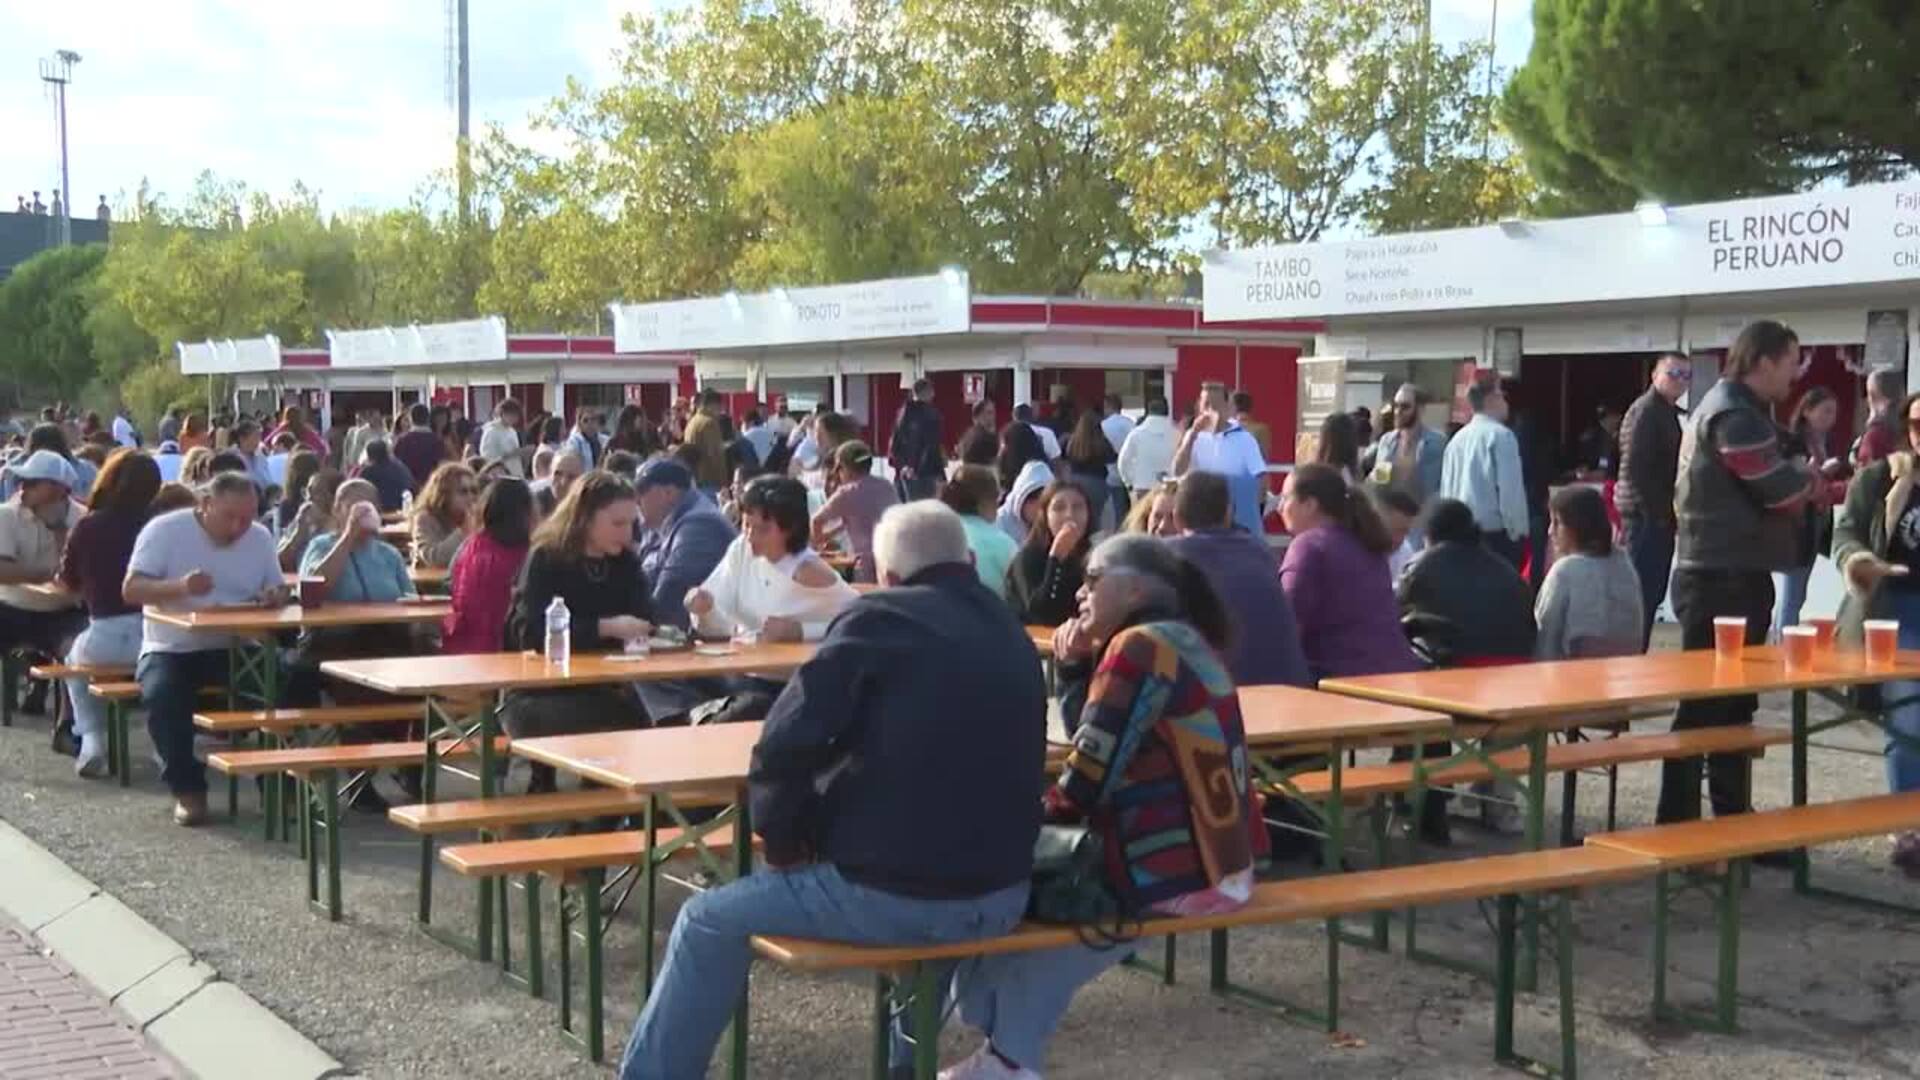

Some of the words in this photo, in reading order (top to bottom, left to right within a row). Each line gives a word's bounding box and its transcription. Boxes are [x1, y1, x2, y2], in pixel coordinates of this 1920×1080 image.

[1708, 219, 1734, 243] EL
[1743, 203, 1850, 241] RINCÓN
[1713, 238, 1844, 271] PERUANO
[1254, 257, 1311, 280] TAMBO
[1246, 279, 1321, 303] PERUANO
[1445, 285, 1473, 298] Brasa
[797, 302, 841, 321] ROKOTO
